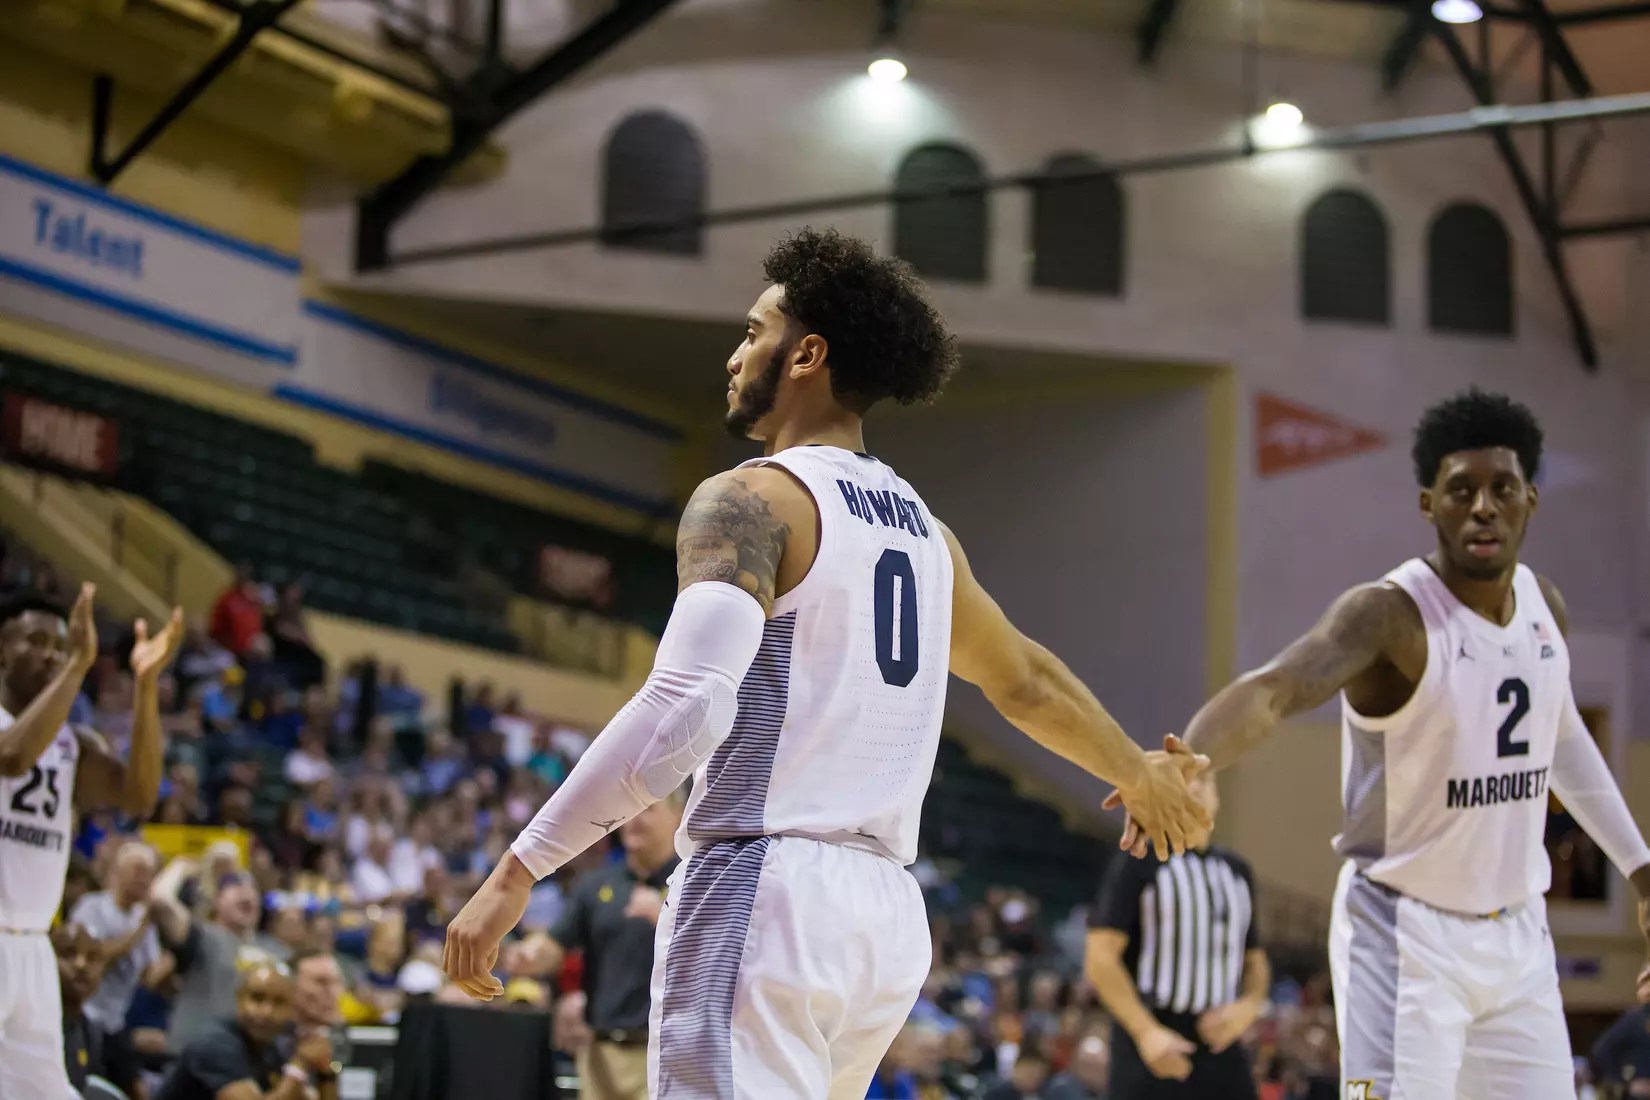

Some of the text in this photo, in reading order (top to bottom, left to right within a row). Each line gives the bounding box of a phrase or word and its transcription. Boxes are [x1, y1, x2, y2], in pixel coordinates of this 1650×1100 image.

[33, 199, 143, 280] Talent
[874, 548, 919, 688] 0
[1497, 677, 1530, 759] 2
[10, 765, 60, 820] 25
